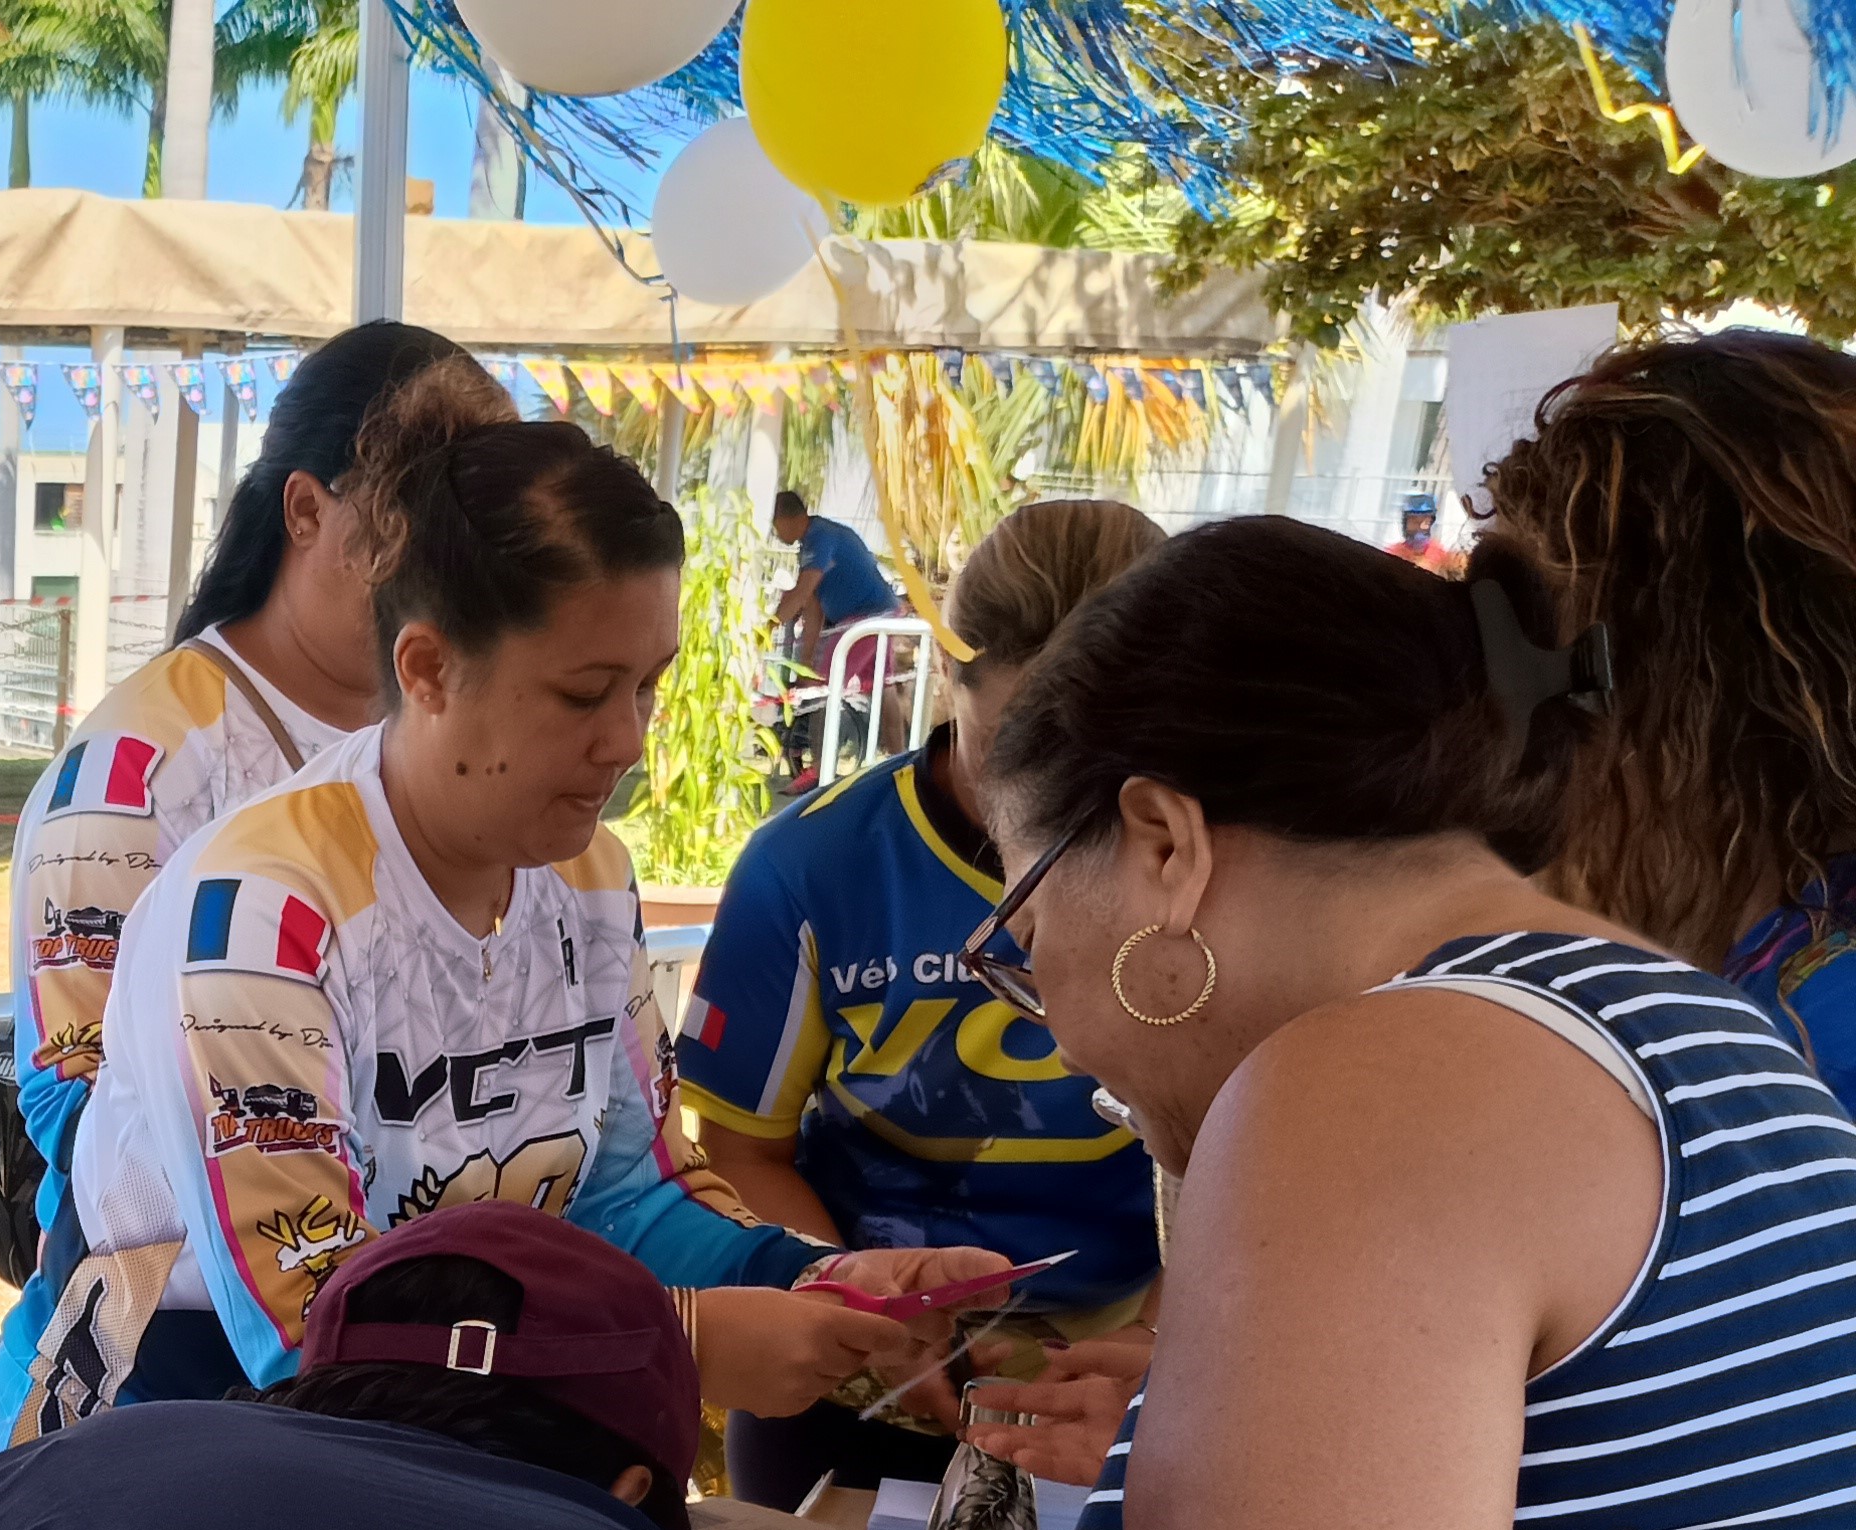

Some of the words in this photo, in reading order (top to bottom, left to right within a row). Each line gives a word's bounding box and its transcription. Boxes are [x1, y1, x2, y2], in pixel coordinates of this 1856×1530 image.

[64, 933, 120, 963] TRUC
[913, 952, 994, 984] Clu
[372, 1016, 617, 1124] VCT
